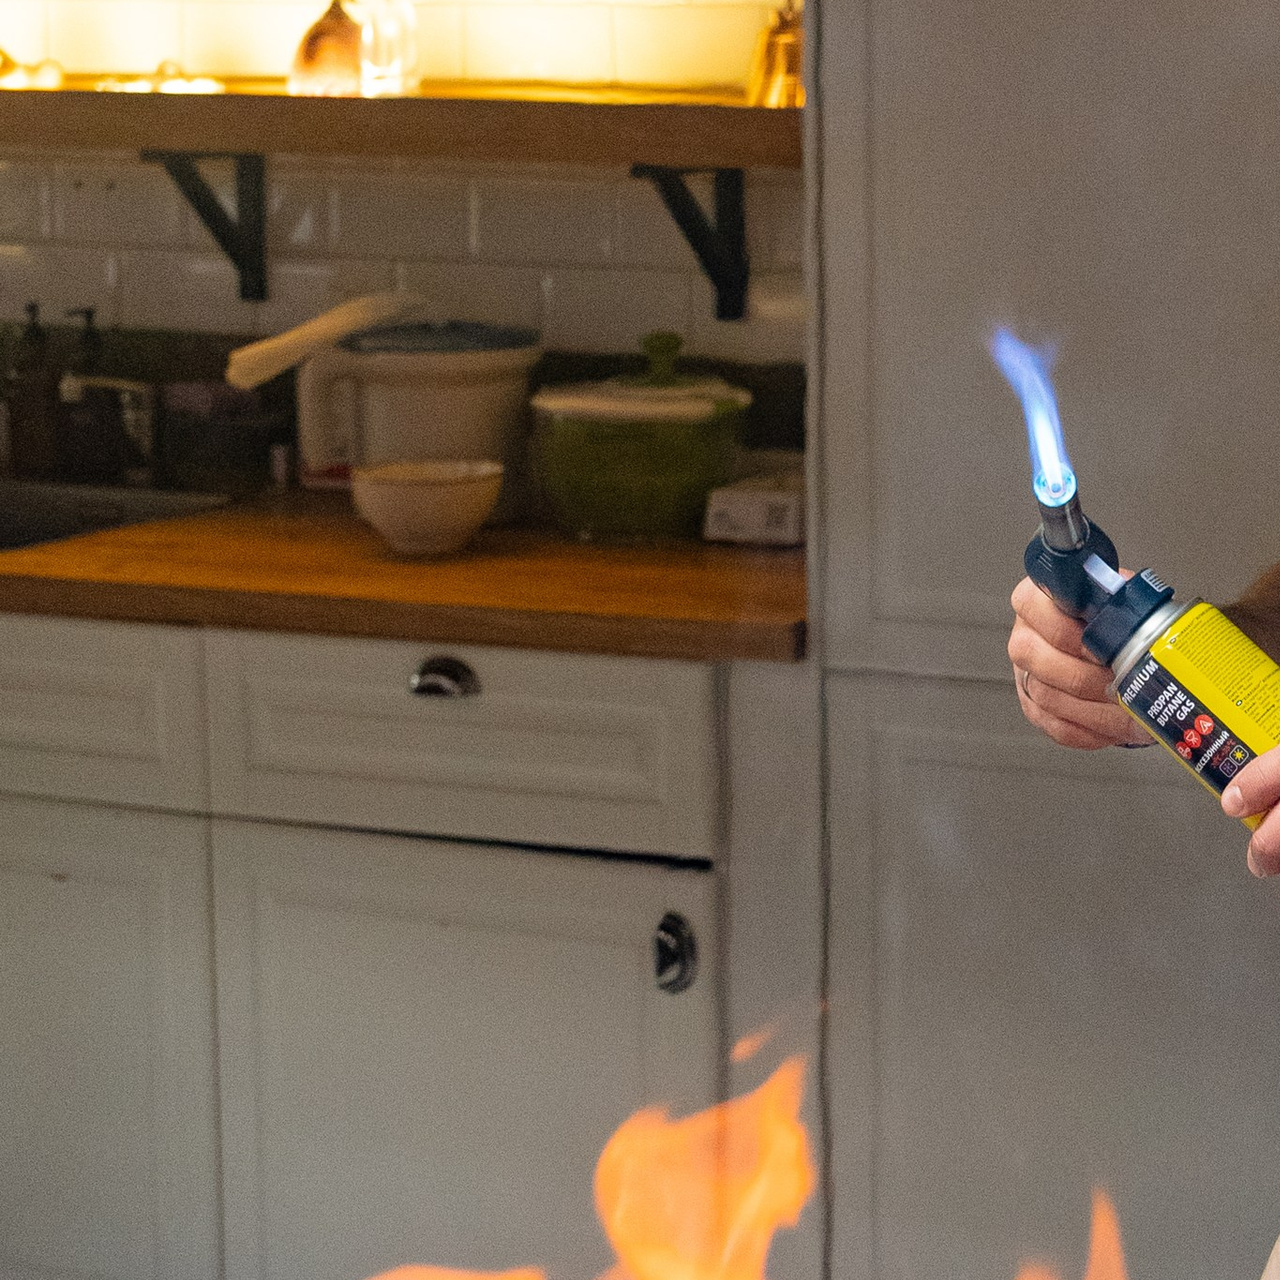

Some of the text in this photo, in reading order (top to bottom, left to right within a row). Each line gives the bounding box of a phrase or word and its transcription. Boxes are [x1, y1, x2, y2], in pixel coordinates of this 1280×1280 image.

[1122, 659, 1159, 706] PREMIUM
[1147, 682, 1179, 720] PROPAN
[1156, 690, 1188, 728] BUTANE
[1176, 698, 1196, 722] GAS
